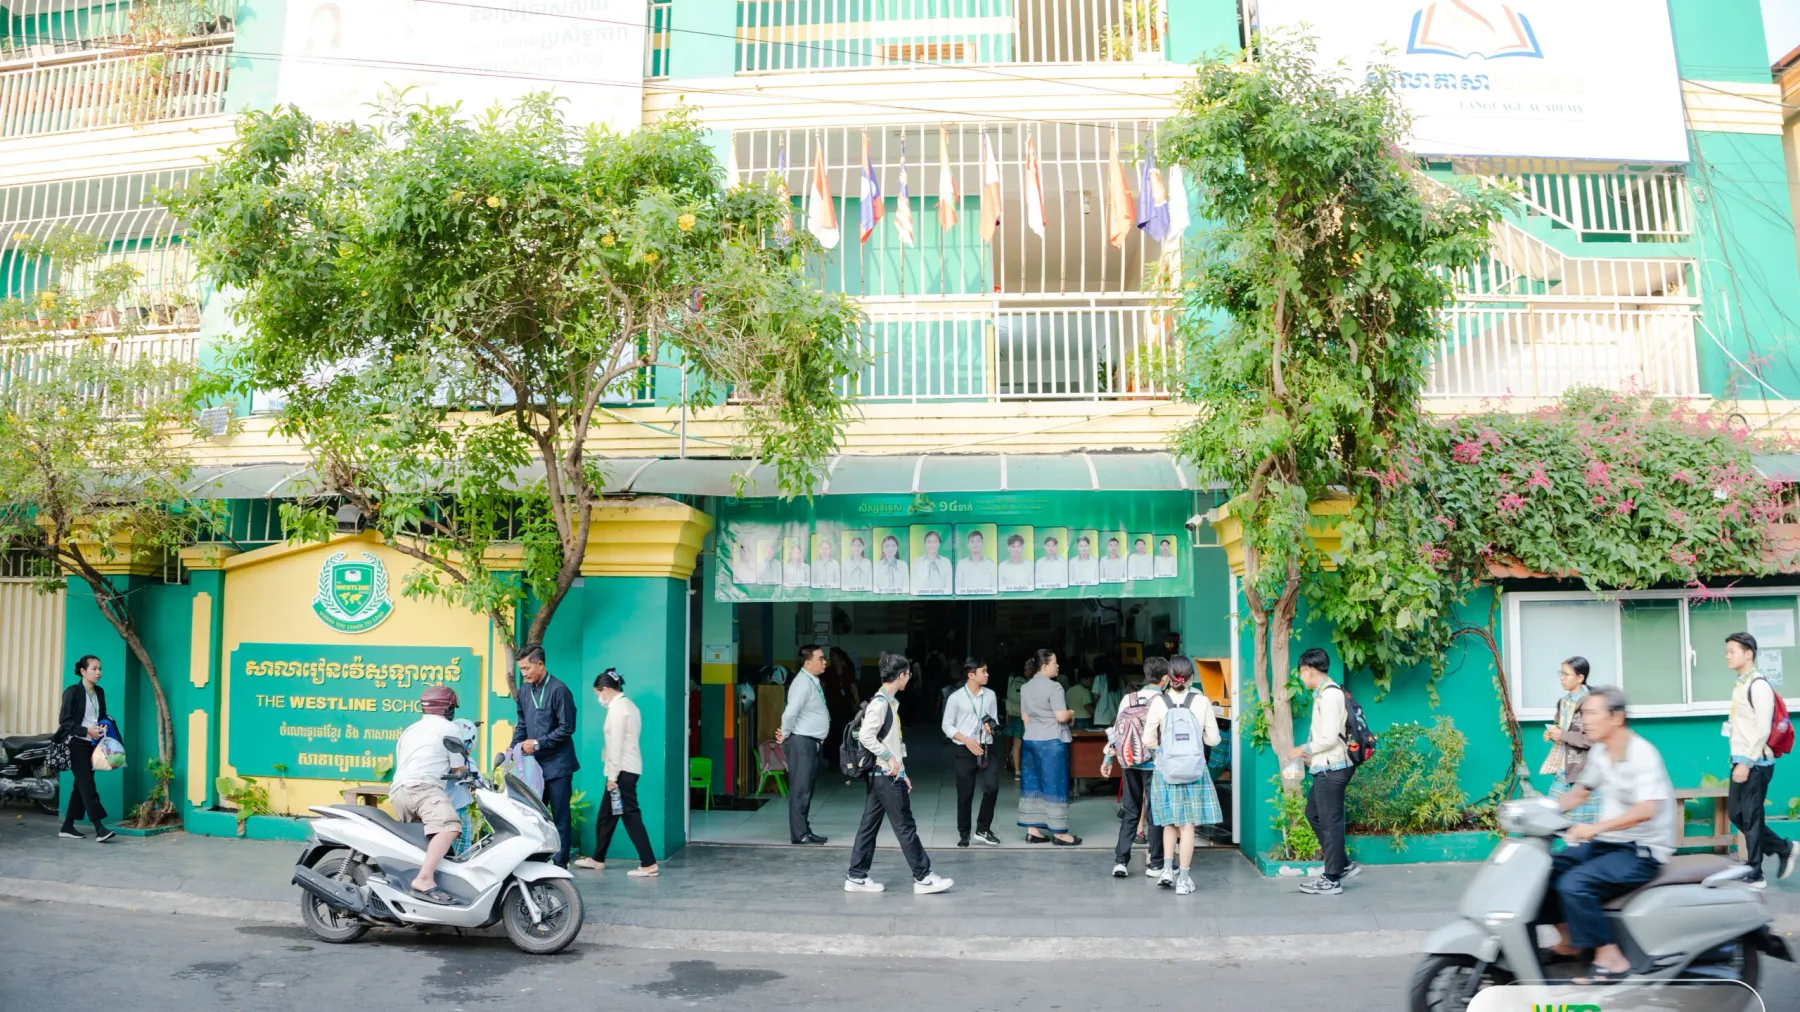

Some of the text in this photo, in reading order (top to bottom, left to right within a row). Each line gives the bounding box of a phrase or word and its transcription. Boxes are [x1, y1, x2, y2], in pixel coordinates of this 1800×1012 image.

[1459, 101, 1584, 113] LANGUAGE ACADEMY
[256, 695, 424, 713] THE WESTLINE SCHO
[345, 723, 360, 740] និង
[363, 727, 404, 741] ភាសាអង់
